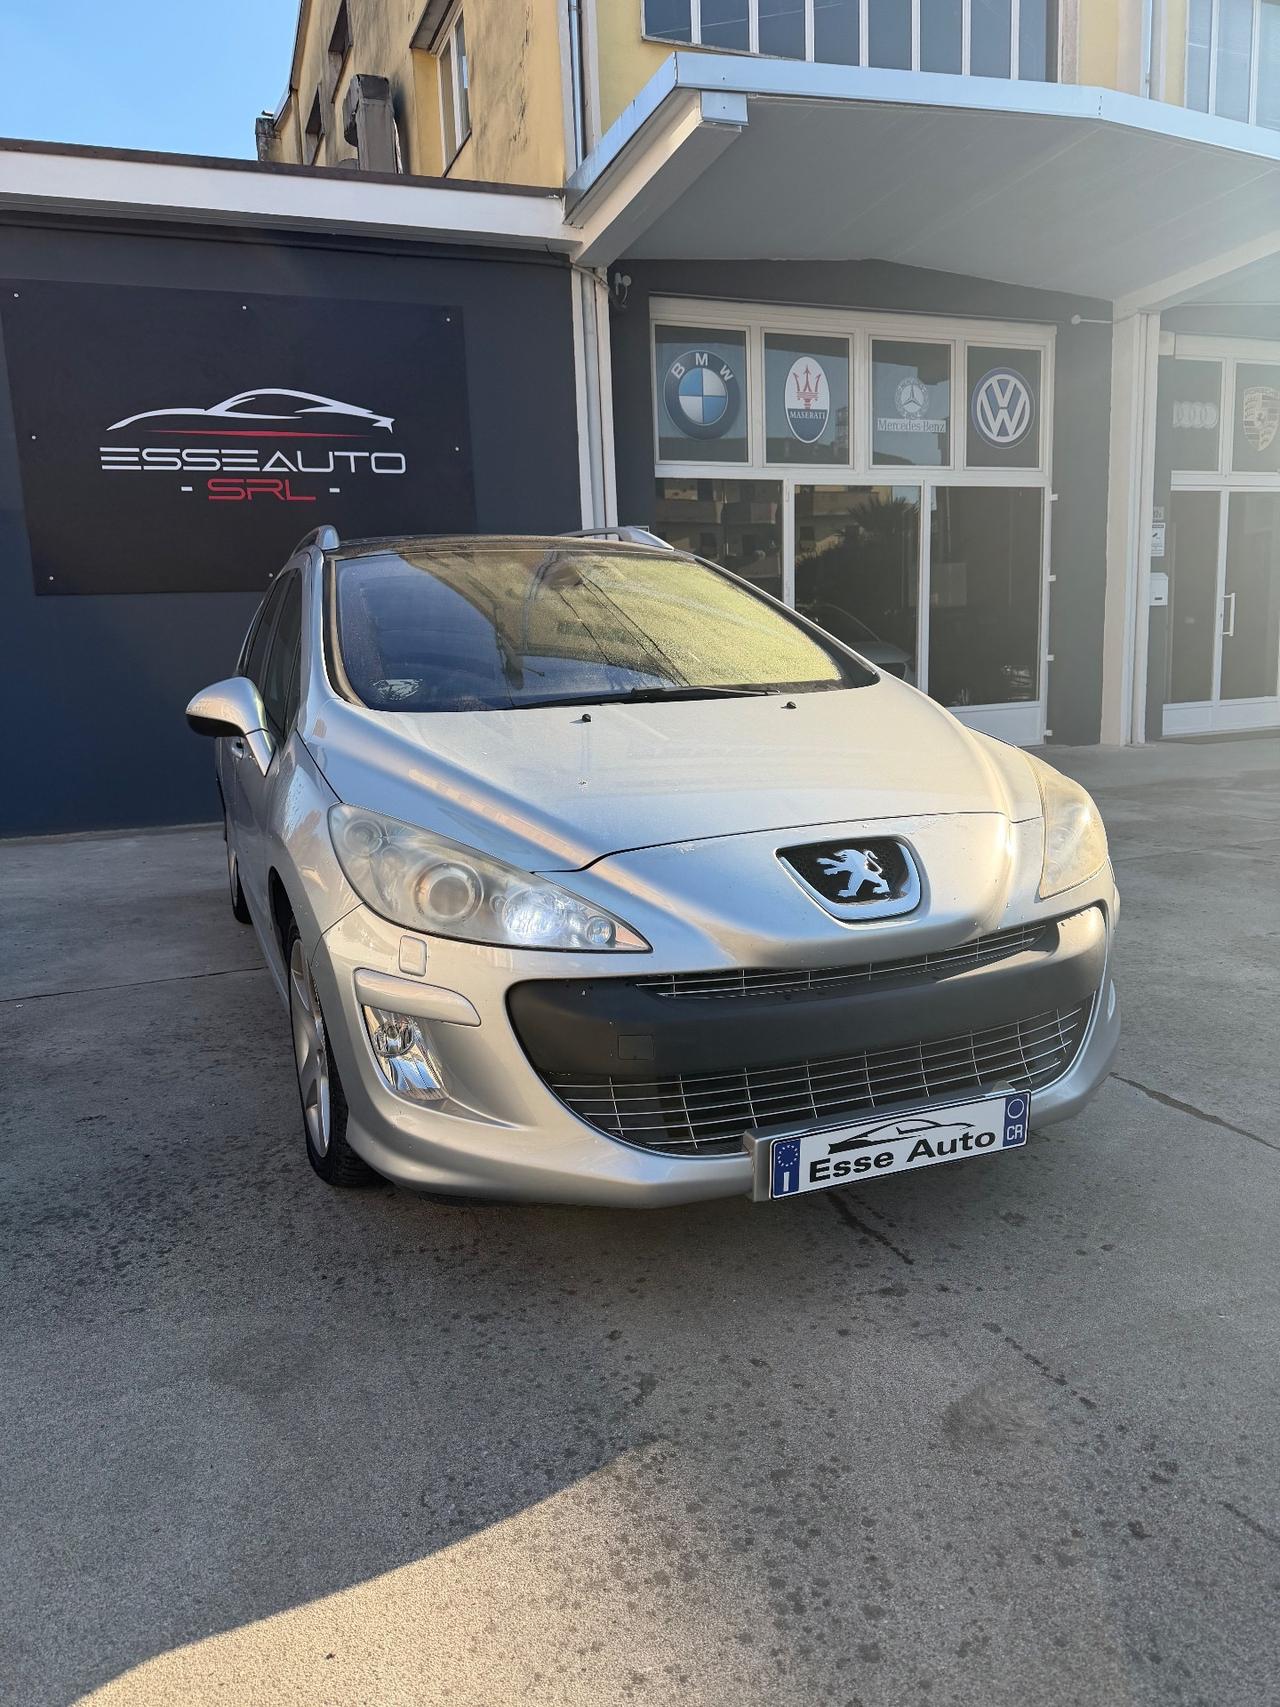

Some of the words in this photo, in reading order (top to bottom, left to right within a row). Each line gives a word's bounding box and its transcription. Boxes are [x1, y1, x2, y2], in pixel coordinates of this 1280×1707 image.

[671, 352, 734, 381] BMW
[790, 410, 825, 420] MASERATI
[207, 478, 316, 501] SRL
[809, 1150, 894, 1183] Esse
[906, 1130, 996, 1163] Auto
